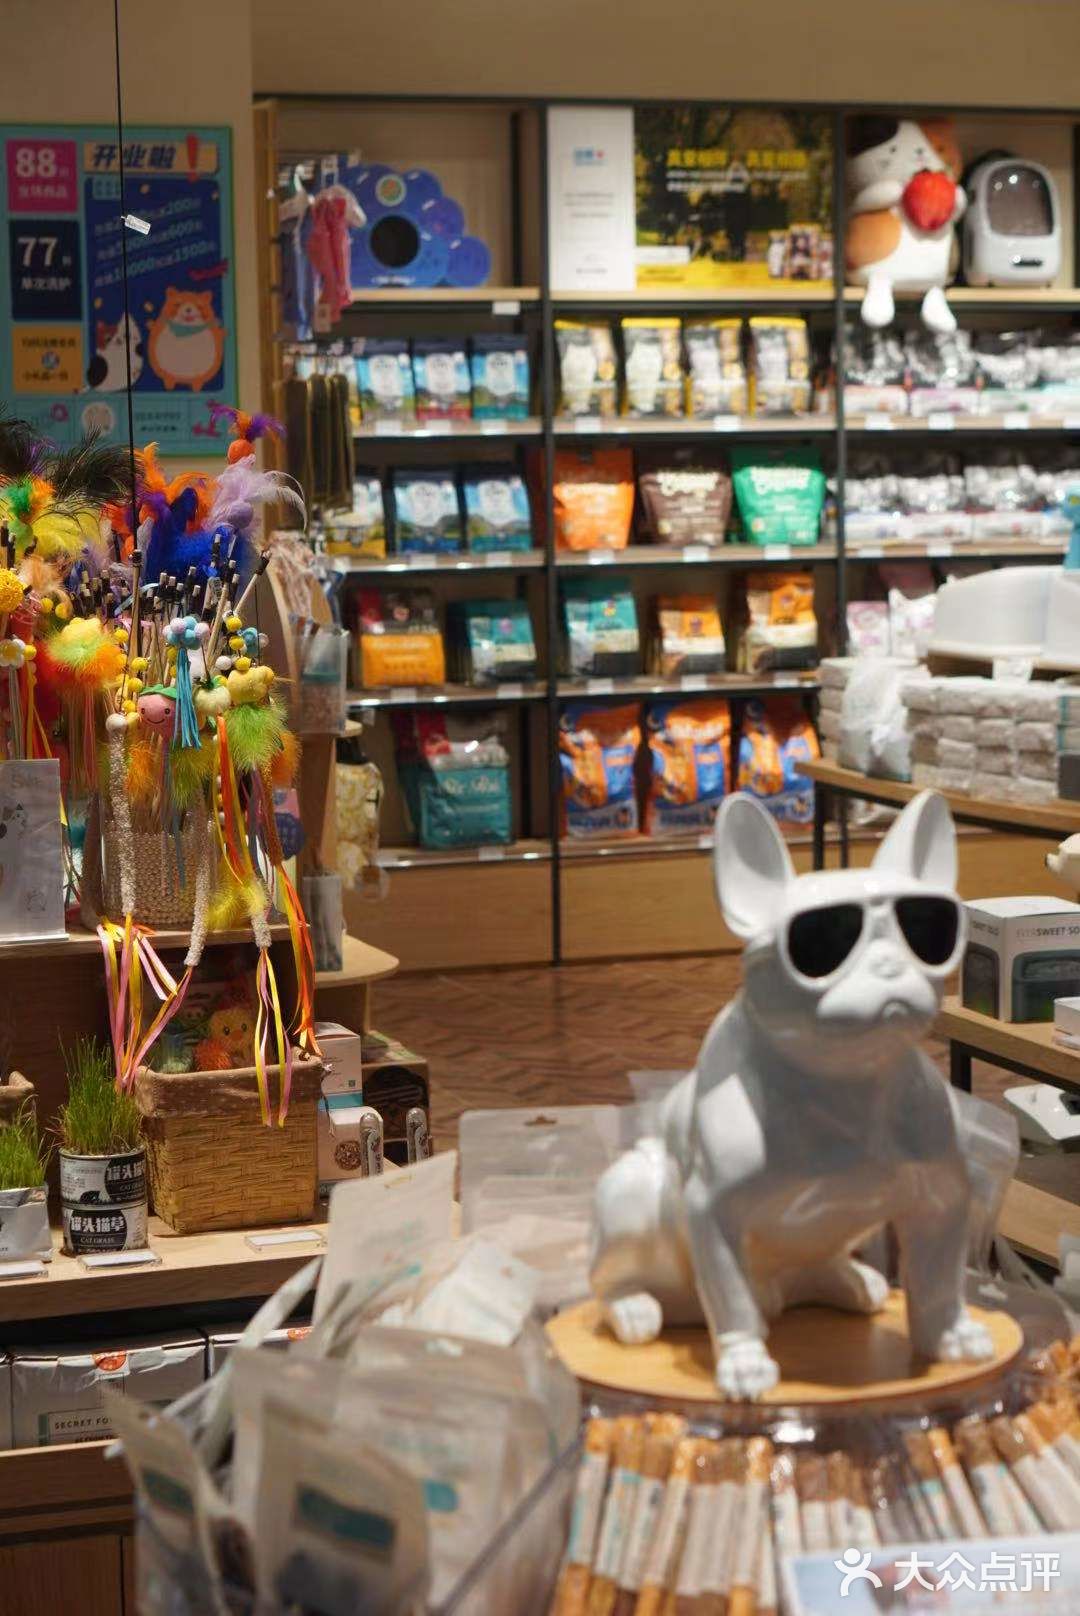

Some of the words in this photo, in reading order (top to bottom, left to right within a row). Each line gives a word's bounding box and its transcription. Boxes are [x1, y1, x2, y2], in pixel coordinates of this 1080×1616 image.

[16, 148, 57, 178] 88
[17, 236, 58, 267] 77
[71, 1216, 125, 1233] 罐头猫草
